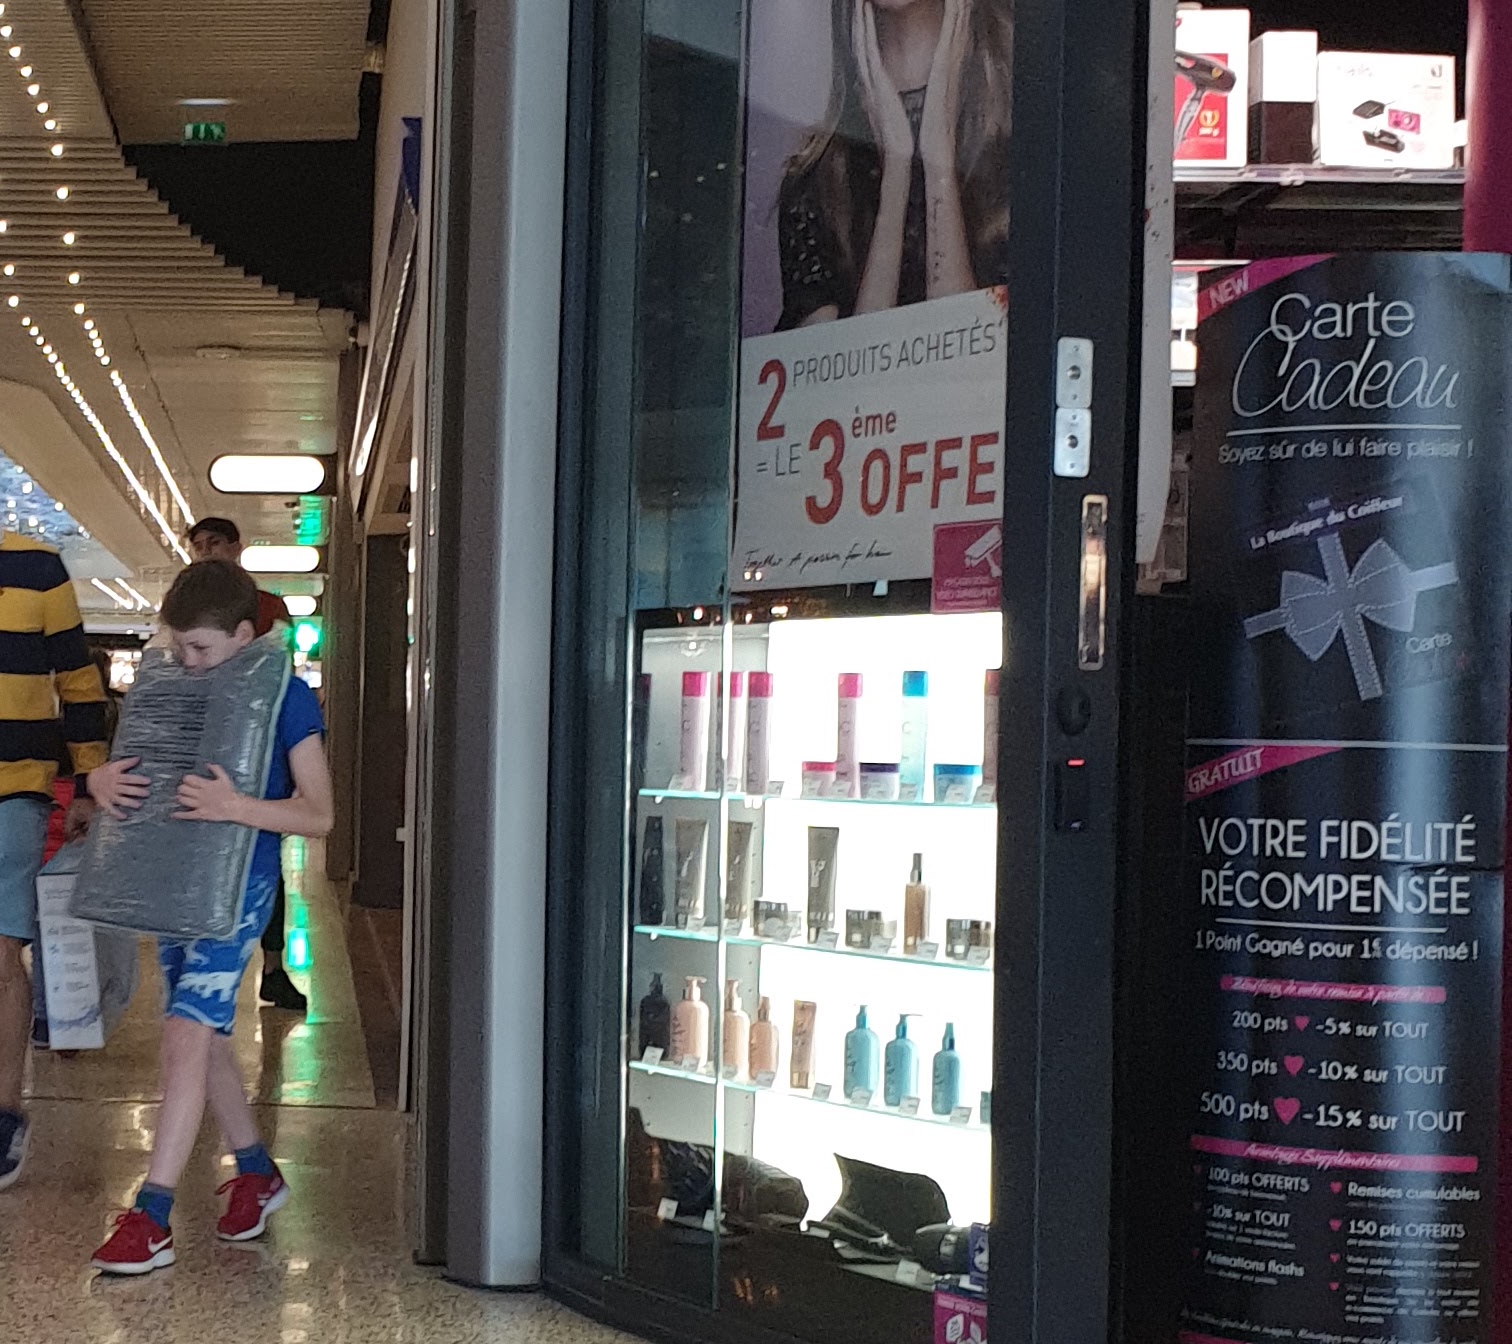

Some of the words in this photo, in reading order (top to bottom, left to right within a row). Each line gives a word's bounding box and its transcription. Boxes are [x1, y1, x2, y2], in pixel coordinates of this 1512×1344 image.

[1208, 272, 1249, 306] NEW
[1270, 292, 1415, 343] Carte
[1232, 325, 1460, 418] Cadeau
[756, 359, 787, 442] 2
[792, 343, 891, 387] PRODUITS
[1218, 443, 1265, 465] Soyez
[1269, 441, 1297, 460] sûr
[1301, 438, 1328, 458] de
[1332, 437, 1355, 457] lui
[1359, 437, 1402, 457] faire
[1407, 439, 1462, 460] plaisir
[775, 443, 802, 476] LE
[861, 431, 1000, 517] OFFE
[1249, 536, 1266, 550] La
[1266, 518, 1325, 545] Boutique
[1326, 510, 1346, 526] du
[1406, 632, 1453, 654] Carte
[1188, 747, 1265, 794] GRATUIT
[1198, 816, 1307, 858] VOTRE
[1319, 812, 1476, 862] FIDÉLITÉ
[1201, 861, 1471, 914] RÉCOMPENSÉE
[1205, 930, 1241, 952] Point
[1245, 933, 1305, 959] Gagné
[1308, 940, 1355, 961] pour
[1386, 938, 1469, 964] dépensé
[1232, 1010, 1261, 1029] 200
[1263, 1014, 1288, 1033] pts
[1315, 1018, 1351, 1035] -5%
[1355, 1023, 1379, 1038] sur
[1383, 1020, 1430, 1040] TOUT
[1216, 1050, 1249, 1072] 350
[1251, 1056, 1278, 1077] pts
[1307, 1061, 1359, 1081] -10%
[1363, 1068, 1390, 1083] sur
[1395, 1064, 1447, 1085] TOUT
[1200, 1091, 1236, 1116] 500
[1239, 1099, 1270, 1122] pts
[1368, 1112, 1399, 1131] sur
[1405, 1109, 1466, 1133] TOUT
[1208, 1167, 1230, 1182] 100
[1231, 1172, 1250, 1186] pts
[1251, 1172, 1311, 1193] OFFERTS
[1347, 1181, 1403, 1199] Remises
[1405, 1186, 1481, 1201] cumulables
[1253, 1209, 1291, 1228] TOUT
[1348, 1219, 1377, 1236] 150
[1379, 1223, 1402, 1238] pts
[1404, 1222, 1466, 1239] OFFERTS
[1205, 1250, 1266, 1272] Animations
